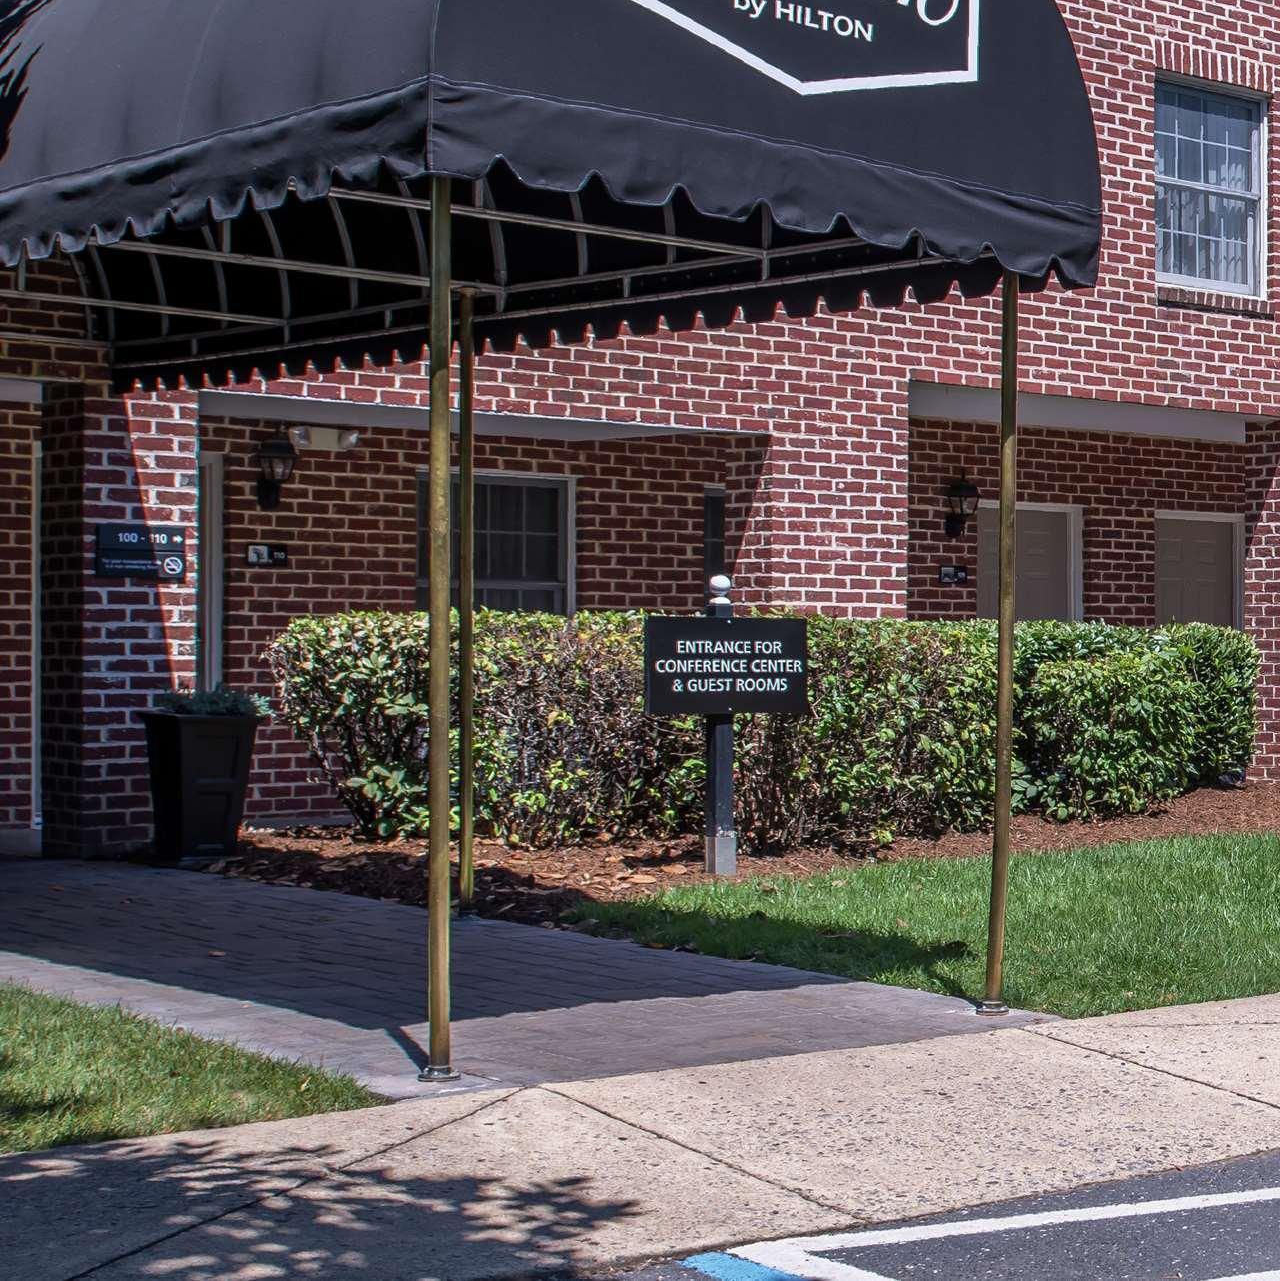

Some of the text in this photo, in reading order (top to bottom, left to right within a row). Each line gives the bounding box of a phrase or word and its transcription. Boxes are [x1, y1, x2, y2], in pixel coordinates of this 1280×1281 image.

[775, 0, 874, 42] HILTON
[117, 532, 138, 543] 100
[150, 533, 168, 544] 110
[676, 640, 782, 654] ENTRANCE FOR
[655, 659, 803, 673] CONFERENCE CENTER
[672, 678, 788, 692] & GUEST ROOMS
